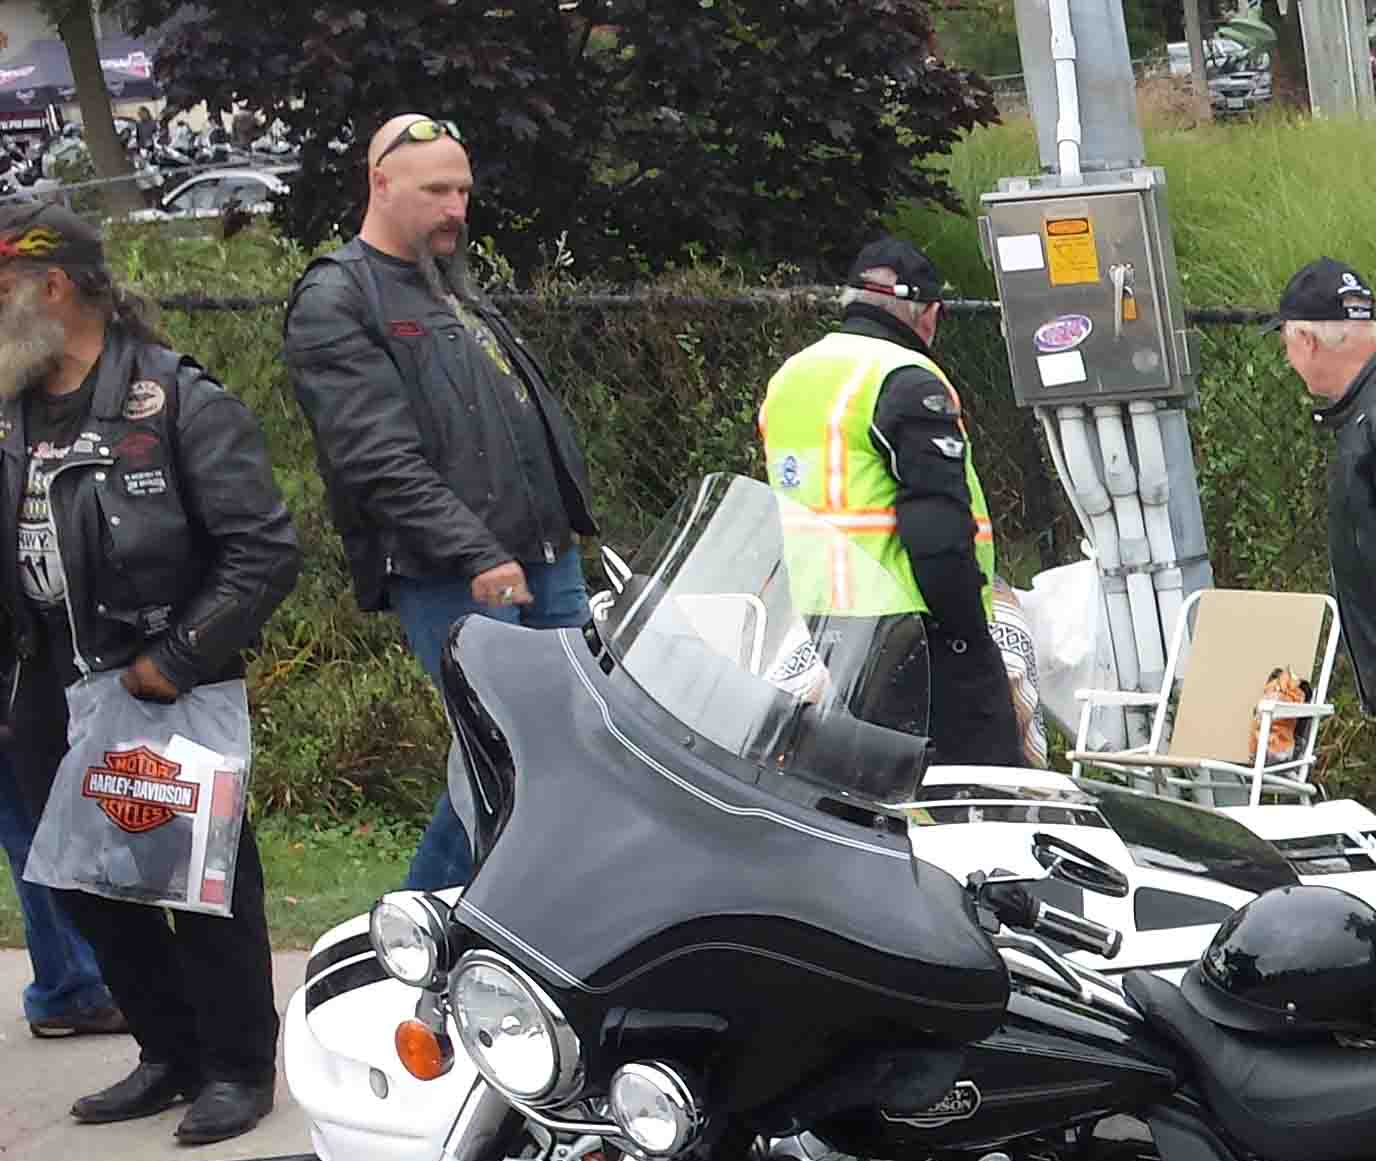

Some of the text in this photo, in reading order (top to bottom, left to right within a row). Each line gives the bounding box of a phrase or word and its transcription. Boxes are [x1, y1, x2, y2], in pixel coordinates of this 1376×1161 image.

[111, 754, 170, 778] MOTOR
[90, 773, 192, 806] HARLEY-DAVIDSON
[105, 799, 163, 824] CYCLES
